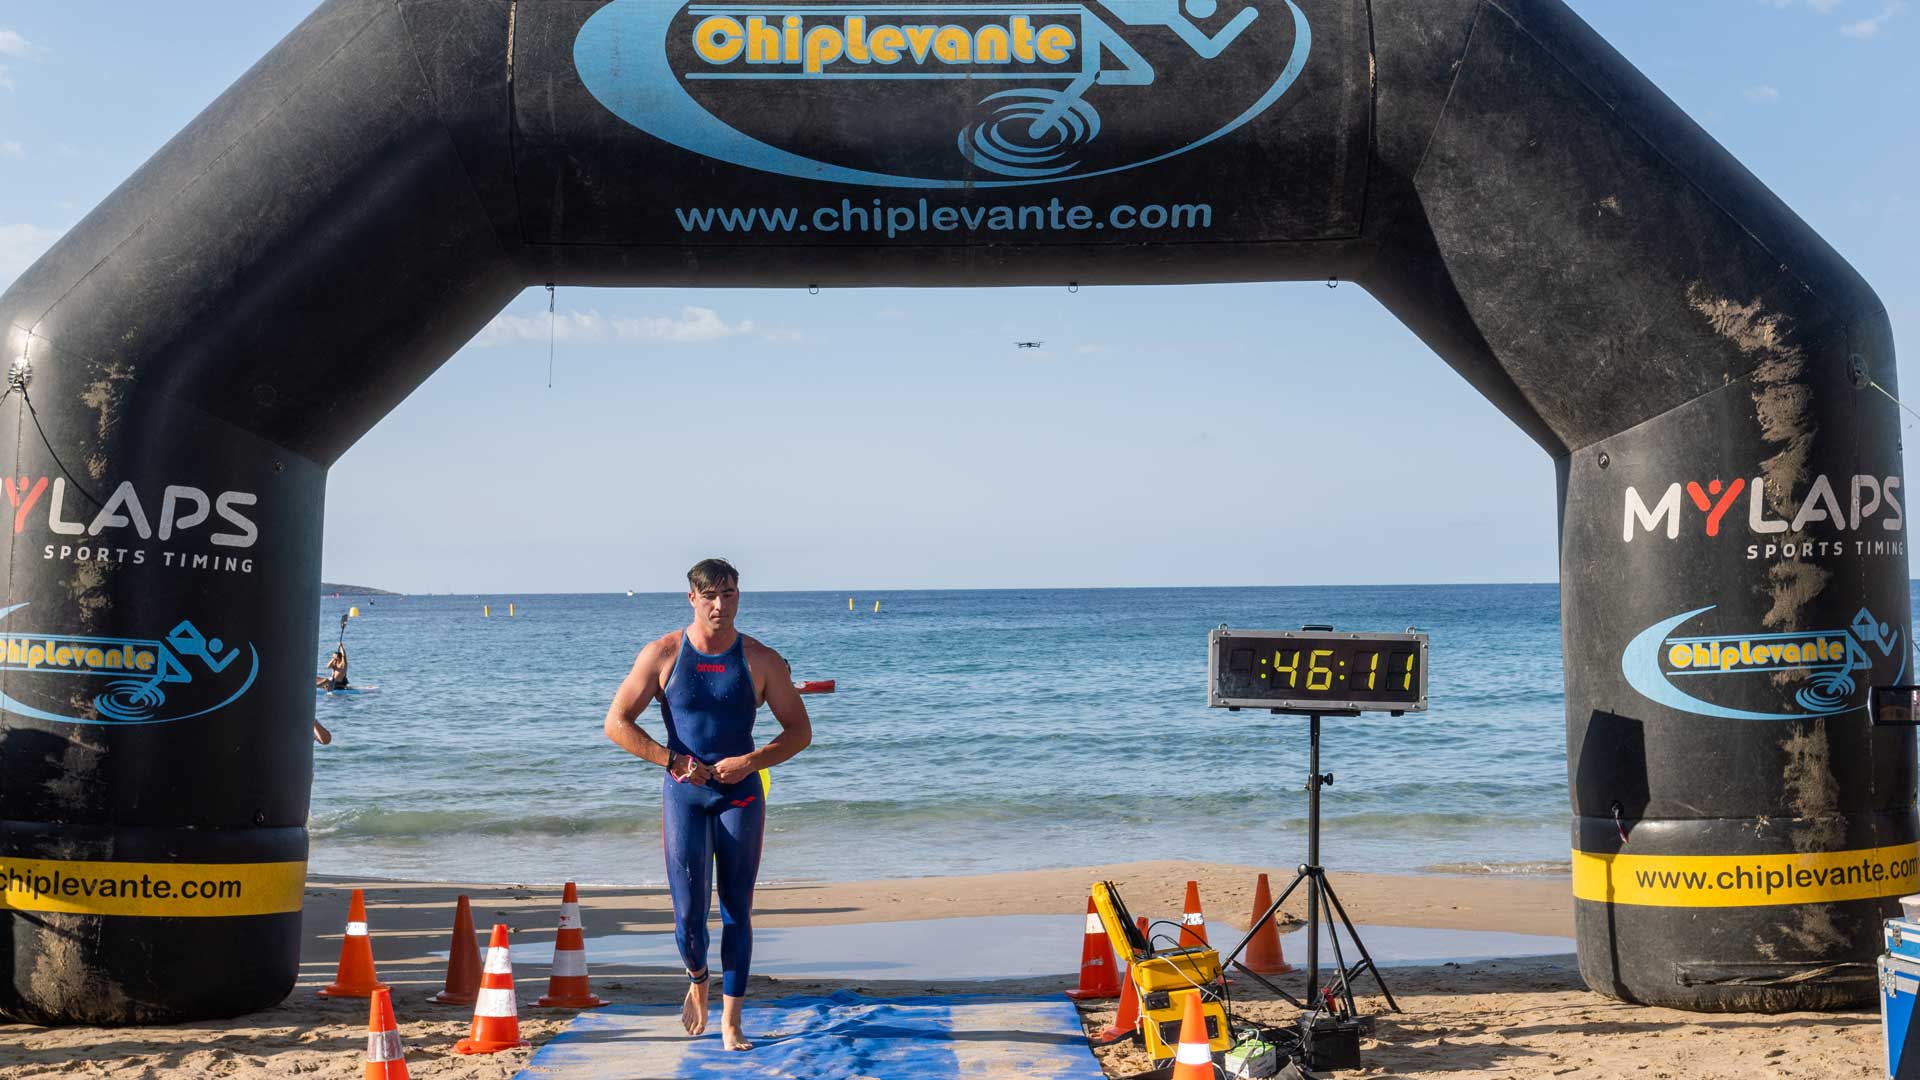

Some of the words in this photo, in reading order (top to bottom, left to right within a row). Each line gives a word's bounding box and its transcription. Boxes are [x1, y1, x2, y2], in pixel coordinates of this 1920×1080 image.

[675, 198, 1213, 239] www.chiplevante.com
[0, 476, 258, 548] YLAPS
[1623, 474, 1903, 543] MYLAPS
[43, 545, 145, 564] SPORTS
[163, 551, 253, 573] TIMING
[1746, 542, 1843, 560] SPORTS
[1855, 541, 1904, 555] TIMING
[696, 663, 726, 672] arena
[1635, 857, 1918, 895] www.chiplevante.com
